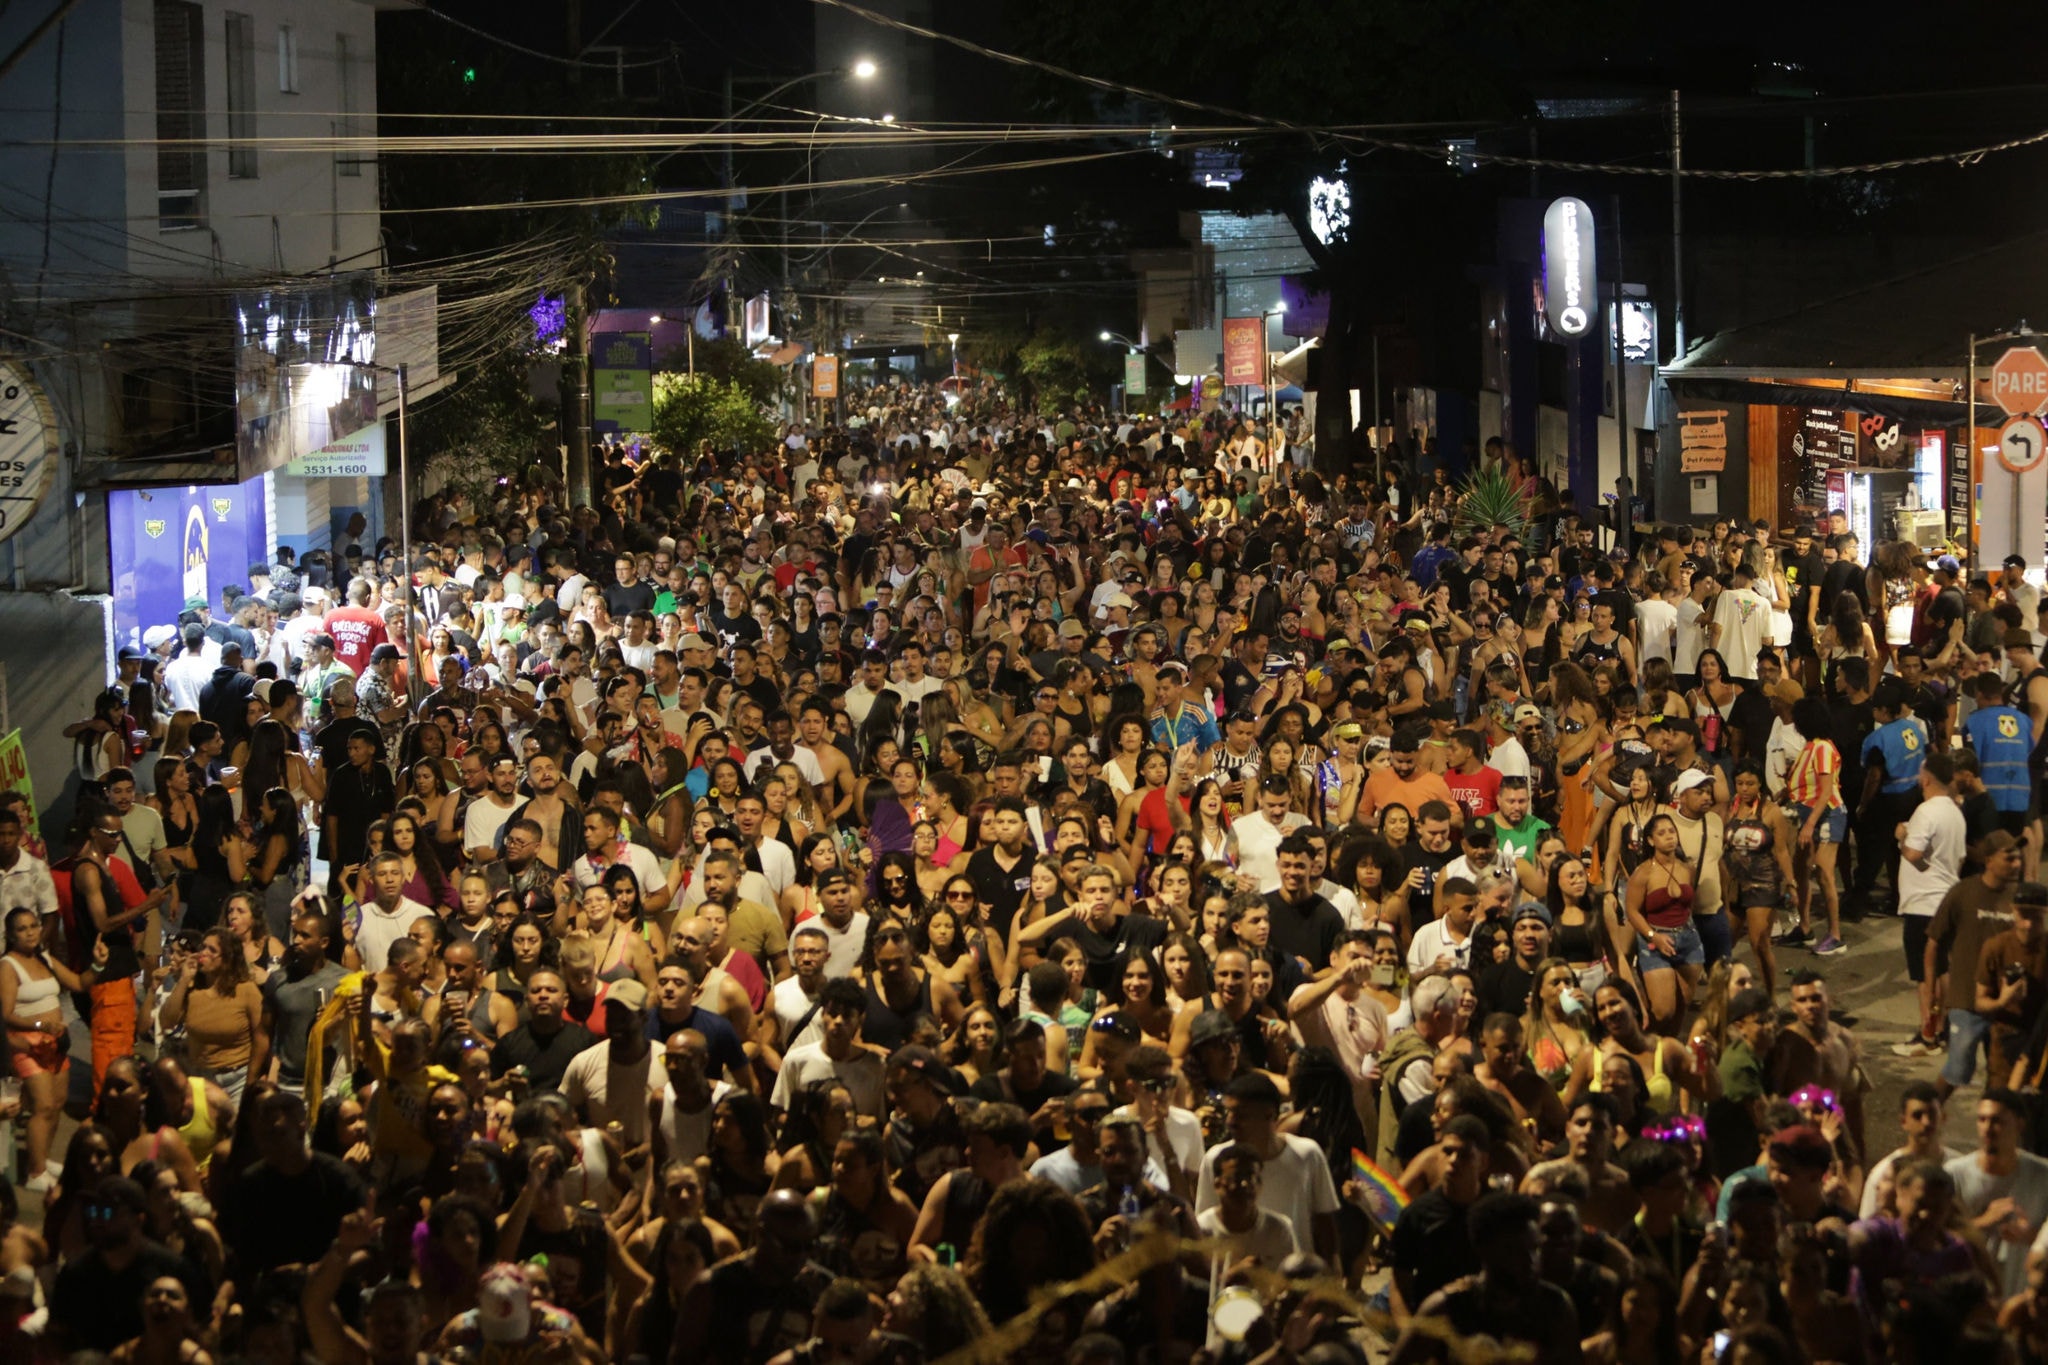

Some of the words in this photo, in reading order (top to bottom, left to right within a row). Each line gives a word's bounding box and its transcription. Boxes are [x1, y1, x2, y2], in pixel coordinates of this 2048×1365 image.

[1562, 201, 1581, 307] BURGERS
[1997, 371, 2048, 394] PARE
[1699, 456, 1723, 464] Friendly
[304, 465, 367, 475] 3531-1600
[1451, 787, 1480, 801] JUST
